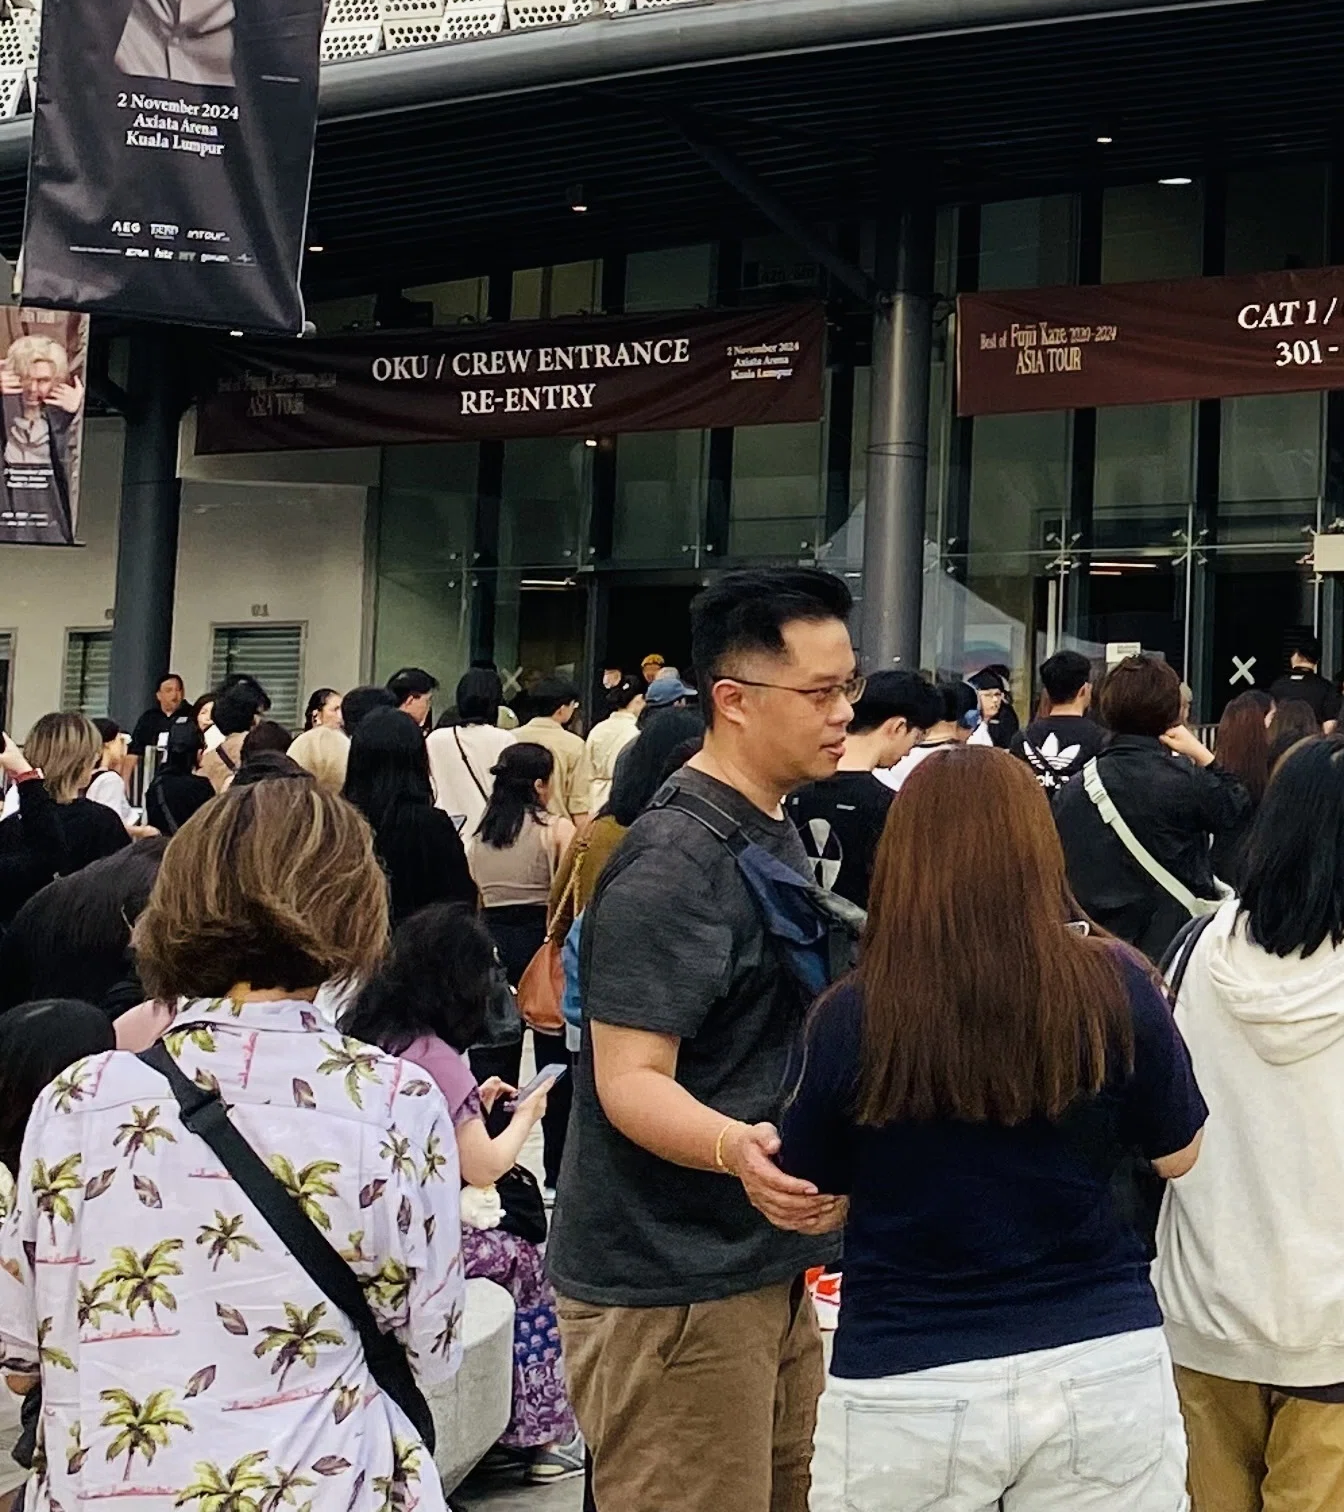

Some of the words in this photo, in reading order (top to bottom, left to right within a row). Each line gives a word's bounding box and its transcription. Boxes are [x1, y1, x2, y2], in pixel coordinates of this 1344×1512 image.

[117, 93, 127, 108] 2
[131, 94, 200, 116] November
[201, 104, 239, 120] 2024
[133, 113, 178, 131] Axiata
[180, 119, 218, 136] Arena
[126, 131, 169, 148] Kuala
[173, 135, 225, 157] Lumpur
[1238, 301, 1300, 329] CAT
[1305, 300, 1317, 324] 1
[1323, 297, 1337, 324] /
[1039, 322, 1067, 345] Kaze
[372, 355, 429, 381] OKU
[435, 354, 446, 379] /
[452, 348, 533, 377] CREW
[537, 338, 690, 372] ENTRANCE
[1016, 350, 1045, 375] ASIA
[1047, 347, 1081, 371] TOUR
[1275, 340, 1323, 366] 301
[461, 383, 596, 415] RE-ENTRY
